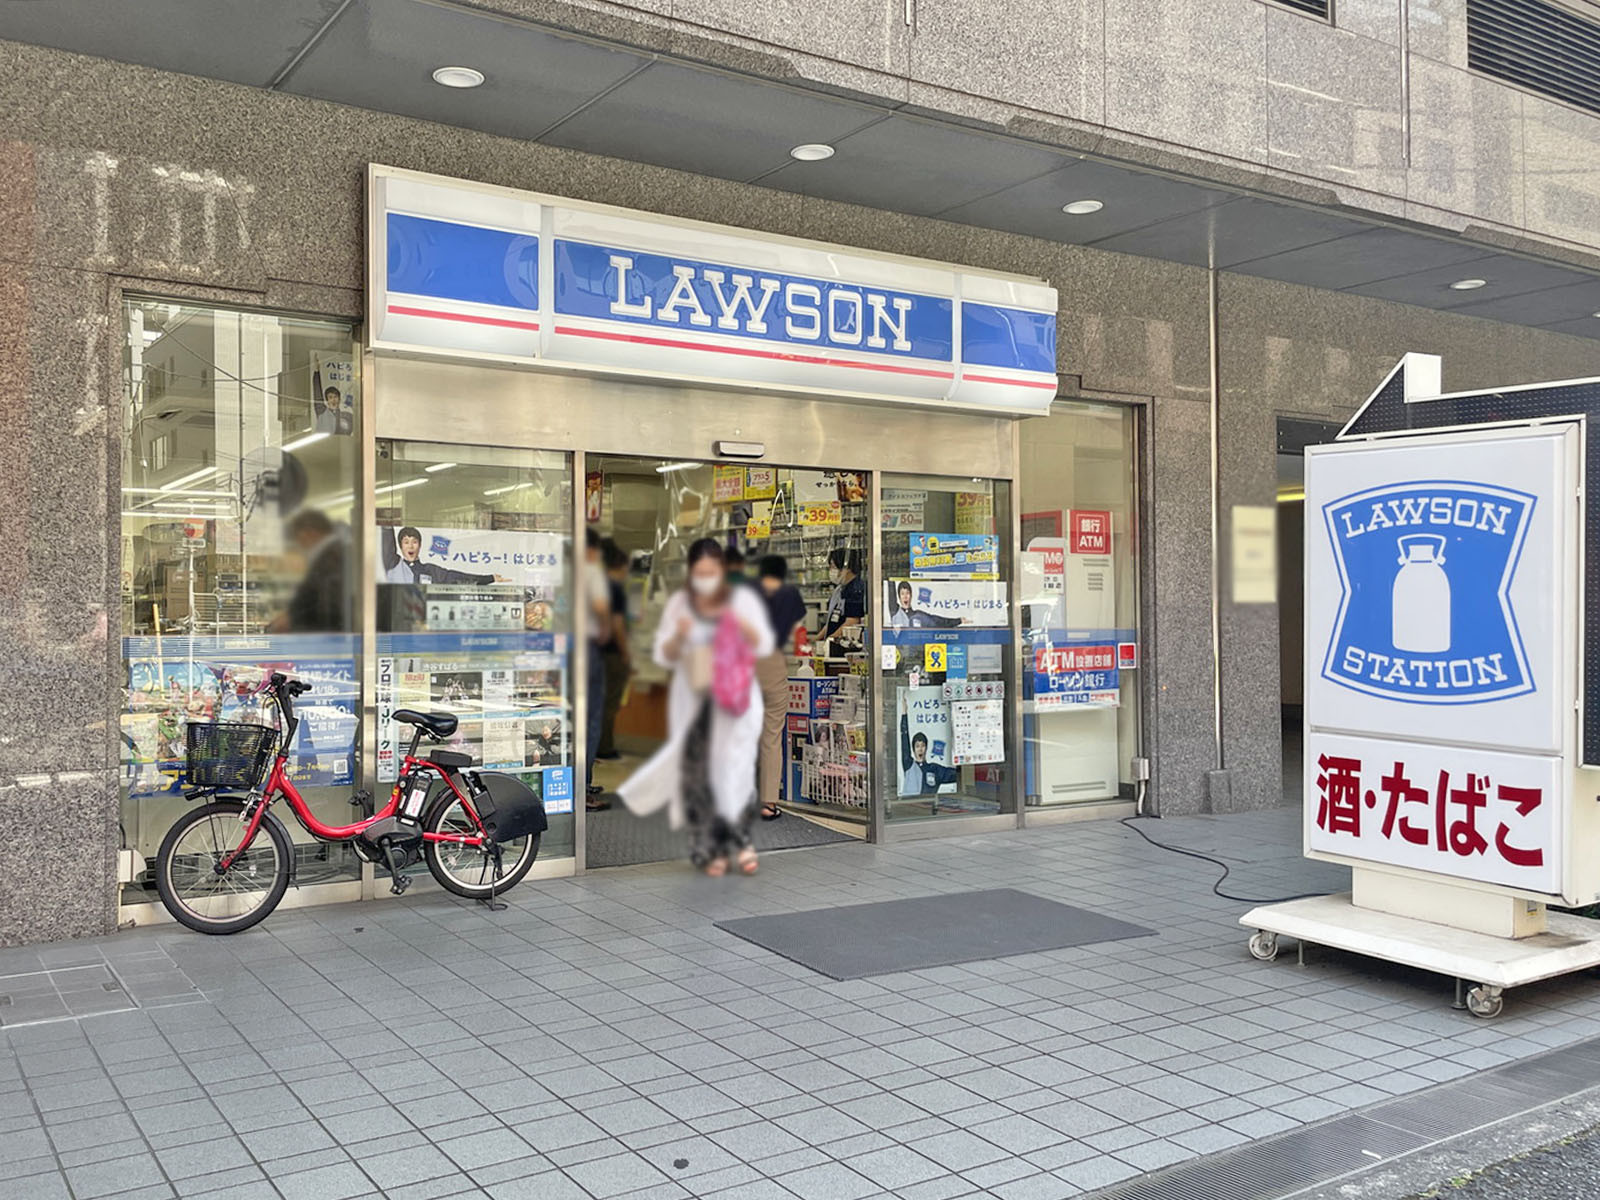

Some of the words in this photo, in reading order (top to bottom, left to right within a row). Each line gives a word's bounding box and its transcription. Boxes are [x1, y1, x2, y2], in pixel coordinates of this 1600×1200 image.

[609, 254, 913, 352] LAWSON
[1341, 496, 1513, 539] LAWSON
[1080, 519, 1101, 533] 銀行
[1079, 535, 1104, 548] ATM
[513, 552, 557, 566] はじまる
[974, 599, 1003, 609] はじまる
[1343, 645, 1508, 689] STATION
[916, 713, 948, 723] はじまる
[1316, 753, 1544, 867] 酒・たばこ
